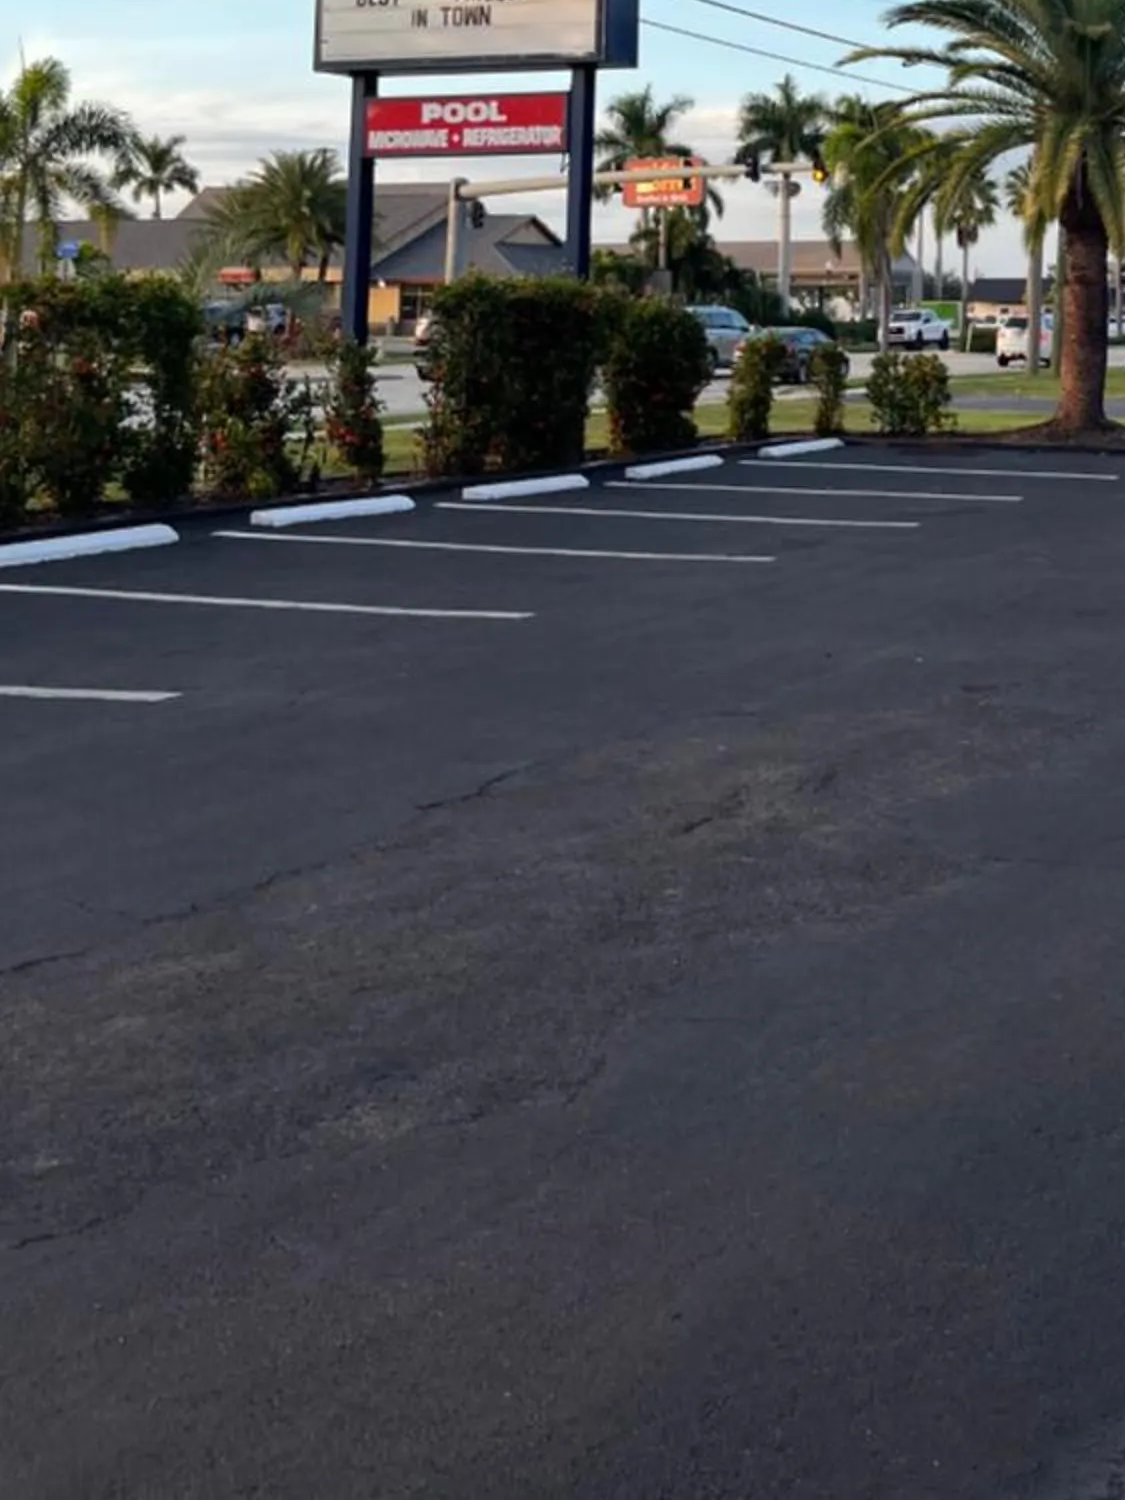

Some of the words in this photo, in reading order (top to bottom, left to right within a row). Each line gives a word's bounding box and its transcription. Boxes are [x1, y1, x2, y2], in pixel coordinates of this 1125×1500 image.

[411, 9, 428, 27] IN
[441, 6, 492, 27] TOWN
[420, 101, 507, 124] POOL
